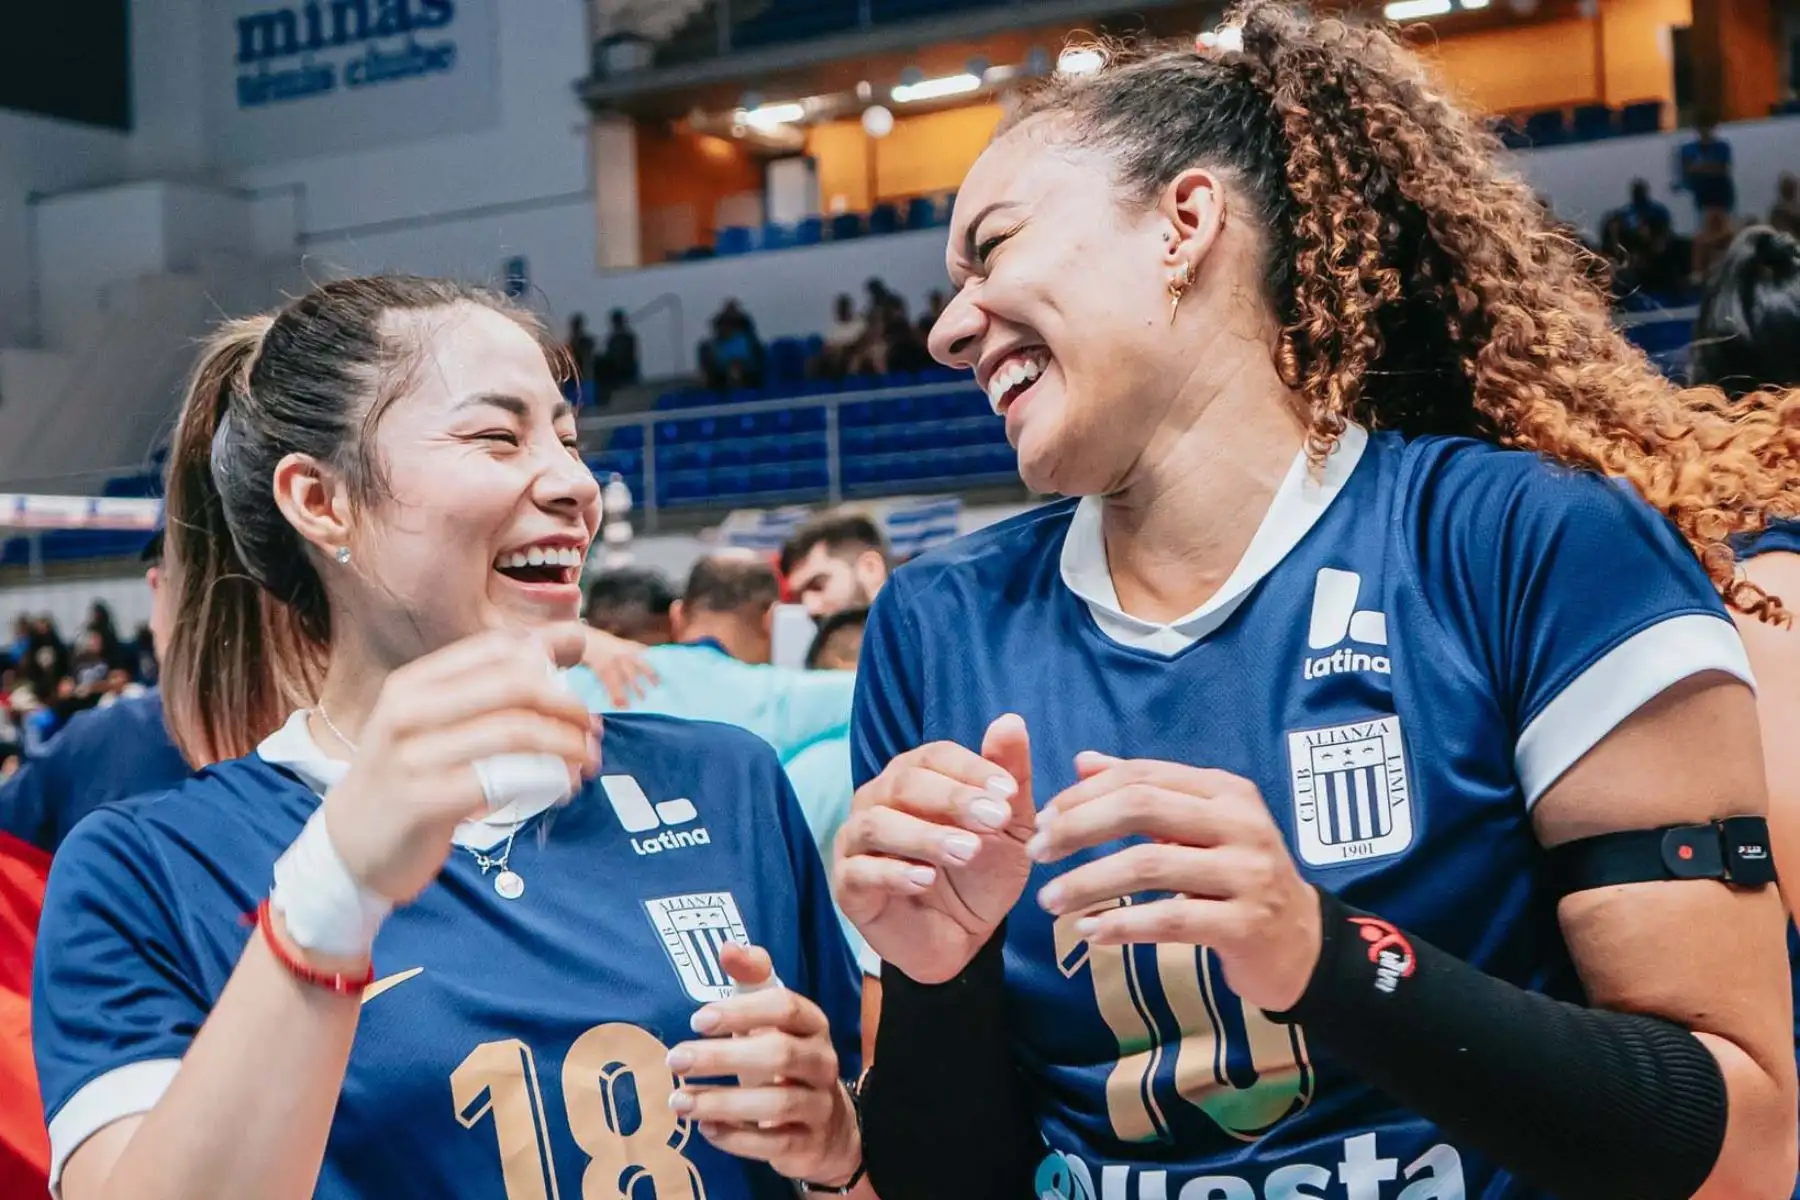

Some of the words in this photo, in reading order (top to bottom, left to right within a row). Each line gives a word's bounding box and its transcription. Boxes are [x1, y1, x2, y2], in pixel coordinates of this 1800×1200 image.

[237, 0, 455, 63] minas
[1303, 648, 1391, 680] latina
[1303, 722, 1390, 747] ALIANZA
[1297, 767, 1316, 823] CLUB
[1387, 754, 1405, 808] LIMA
[630, 827, 711, 855] latina
[1342, 842, 1375, 859] 1901
[659, 895, 726, 912] ALIANZA
[662, 926, 691, 967] CLUB
[718, 987, 734, 999] 19
[450, 1021, 708, 1200] 18
